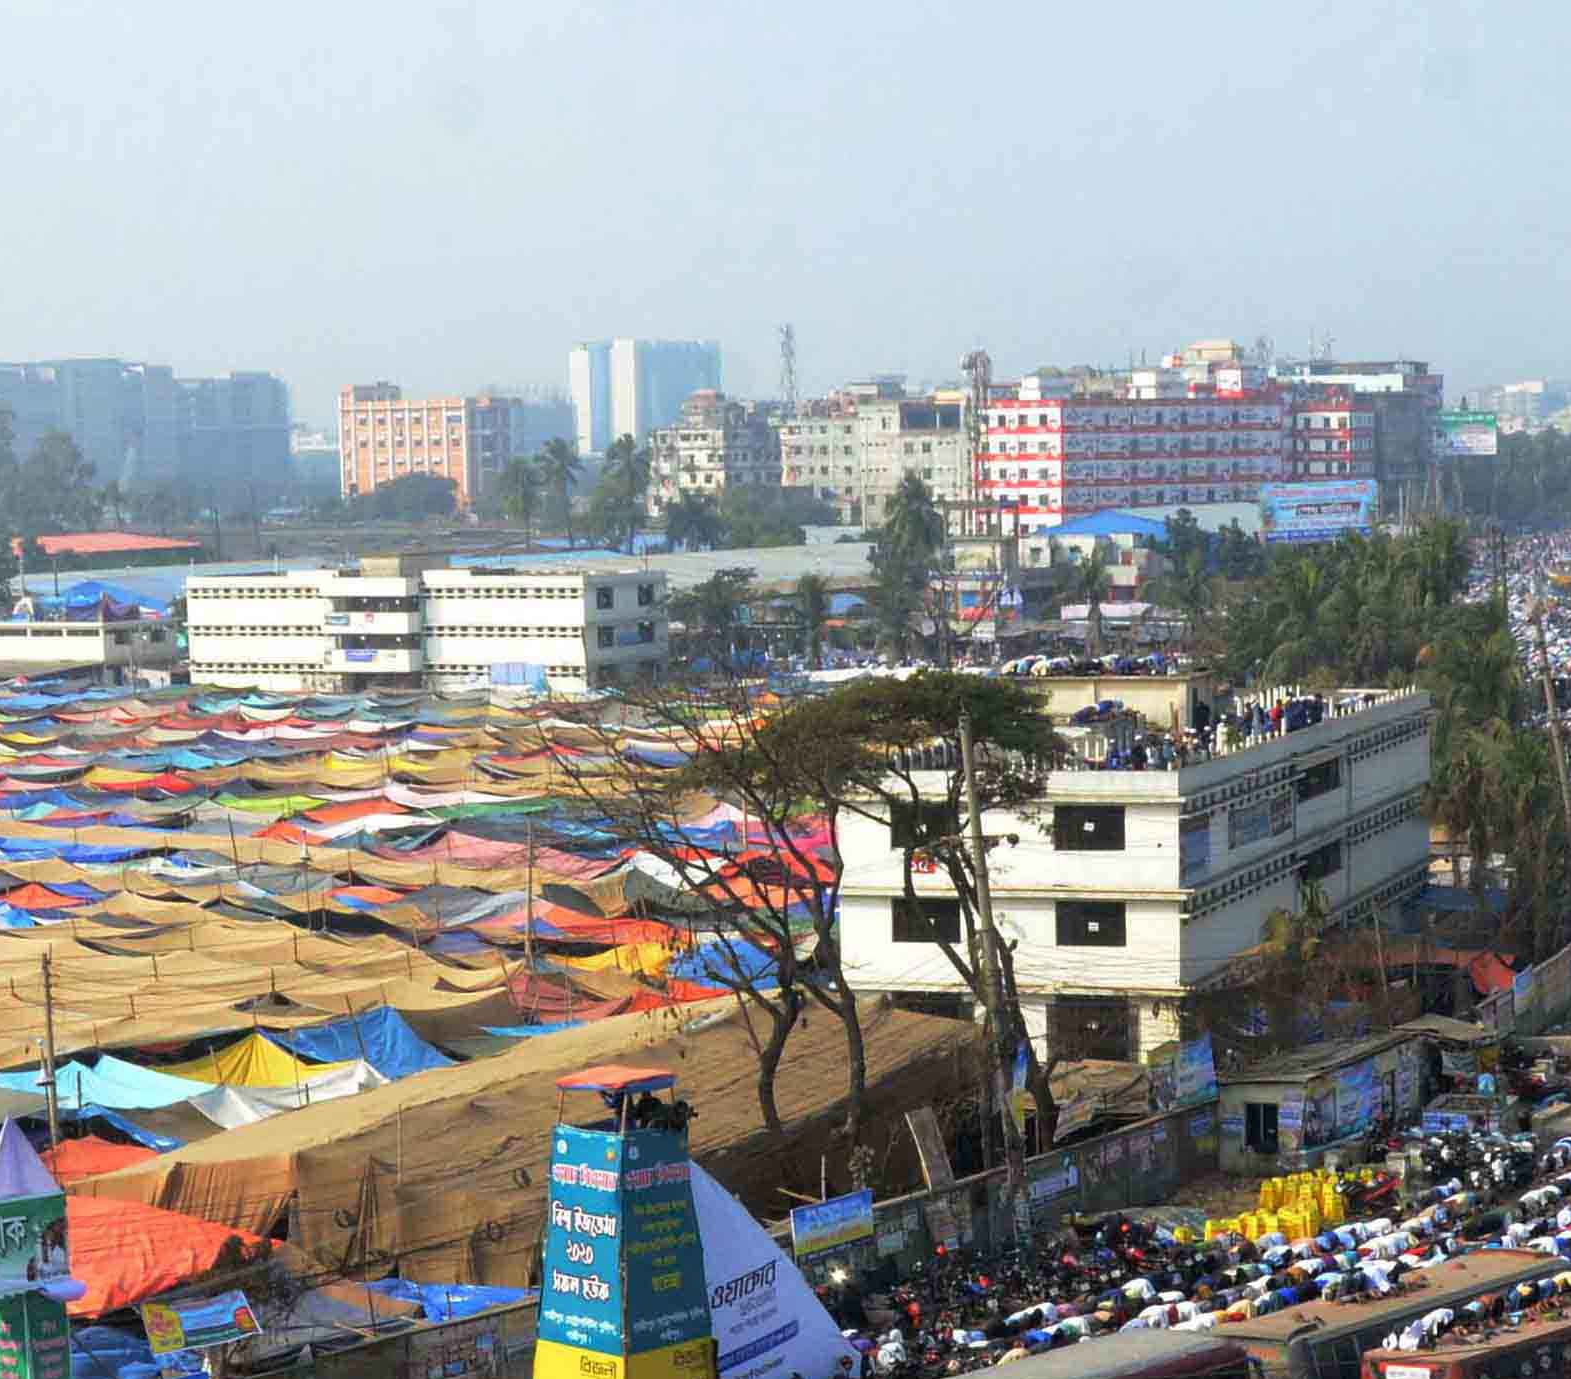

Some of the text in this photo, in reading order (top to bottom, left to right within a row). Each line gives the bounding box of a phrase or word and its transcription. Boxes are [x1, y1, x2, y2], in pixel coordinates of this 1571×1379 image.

[553, 1201, 616, 1237] বিশ্ব ইজতেমা
[567, 1240, 594, 1265] ২০২০
[553, 1269, 579, 1297] সফল
[711, 1259, 777, 1309] ওয়াকার
